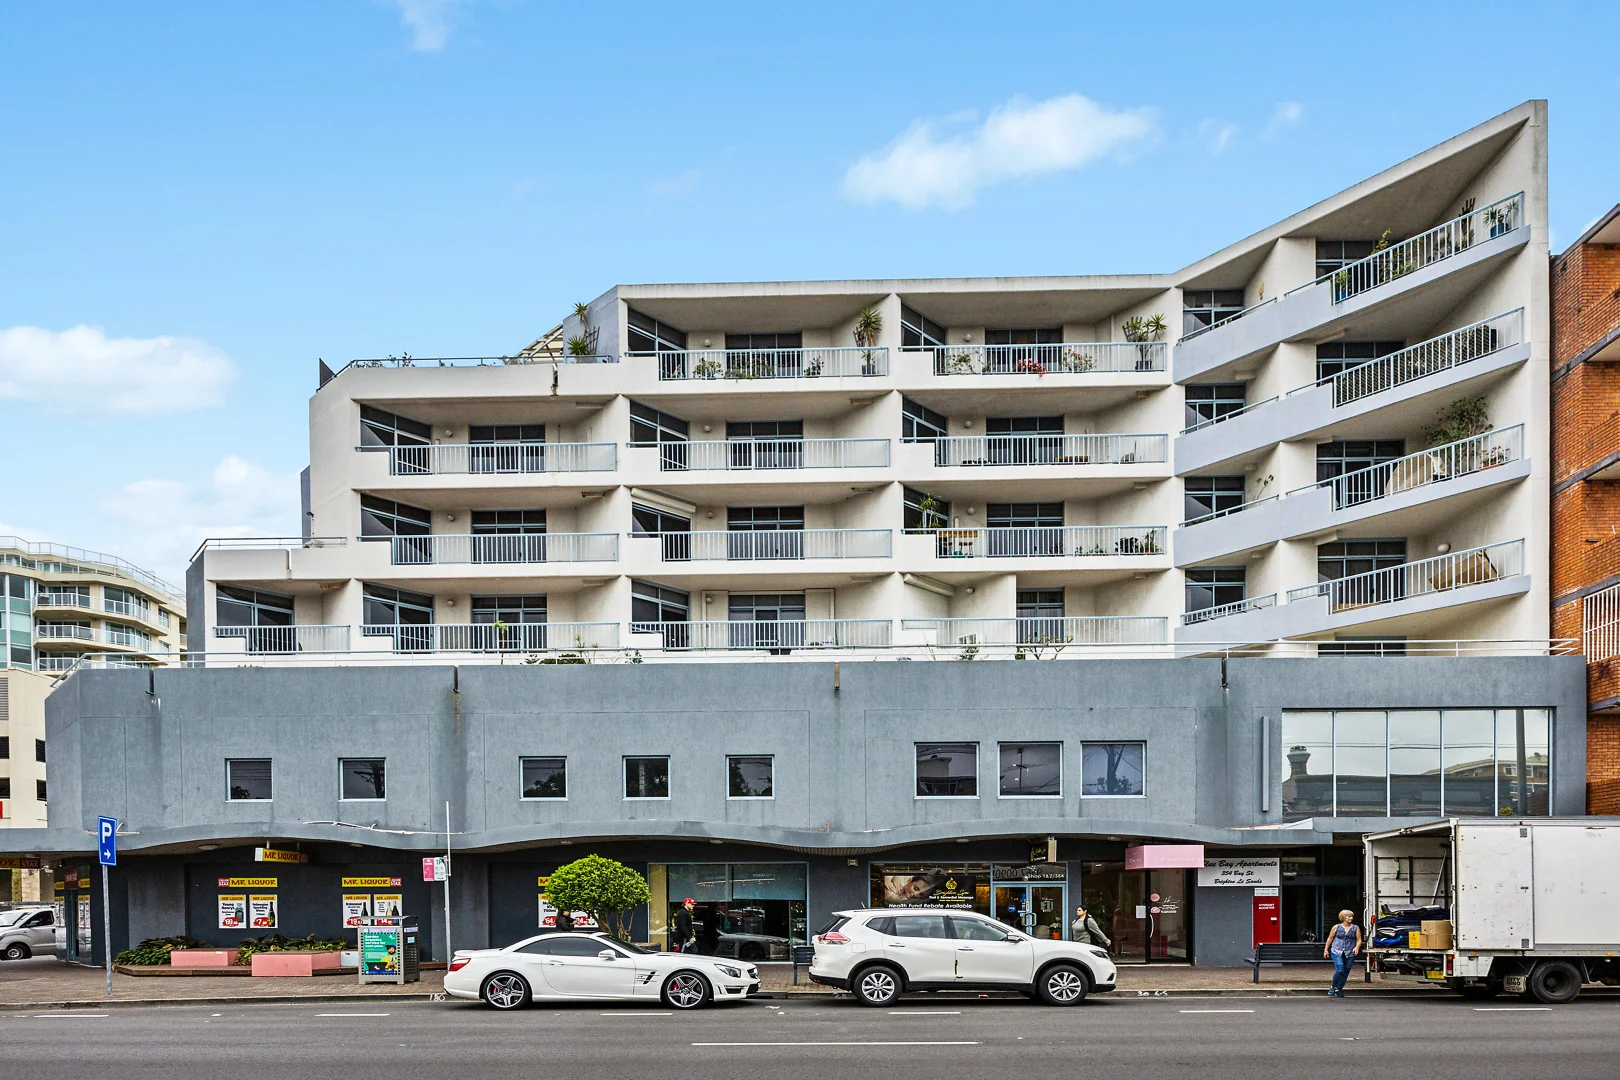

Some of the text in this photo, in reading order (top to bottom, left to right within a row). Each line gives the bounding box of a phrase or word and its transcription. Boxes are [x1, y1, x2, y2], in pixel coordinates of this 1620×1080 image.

[102, 822, 112, 843] P
[264, 851, 276, 860] MR
[278, 852, 299, 861] LIQUOR
[1204, 860, 1216, 868] lue
[1219, 860, 1233, 868] Bay
[1235, 859, 1277, 868] Apartments
[1283, 863, 1298, 871] 354
